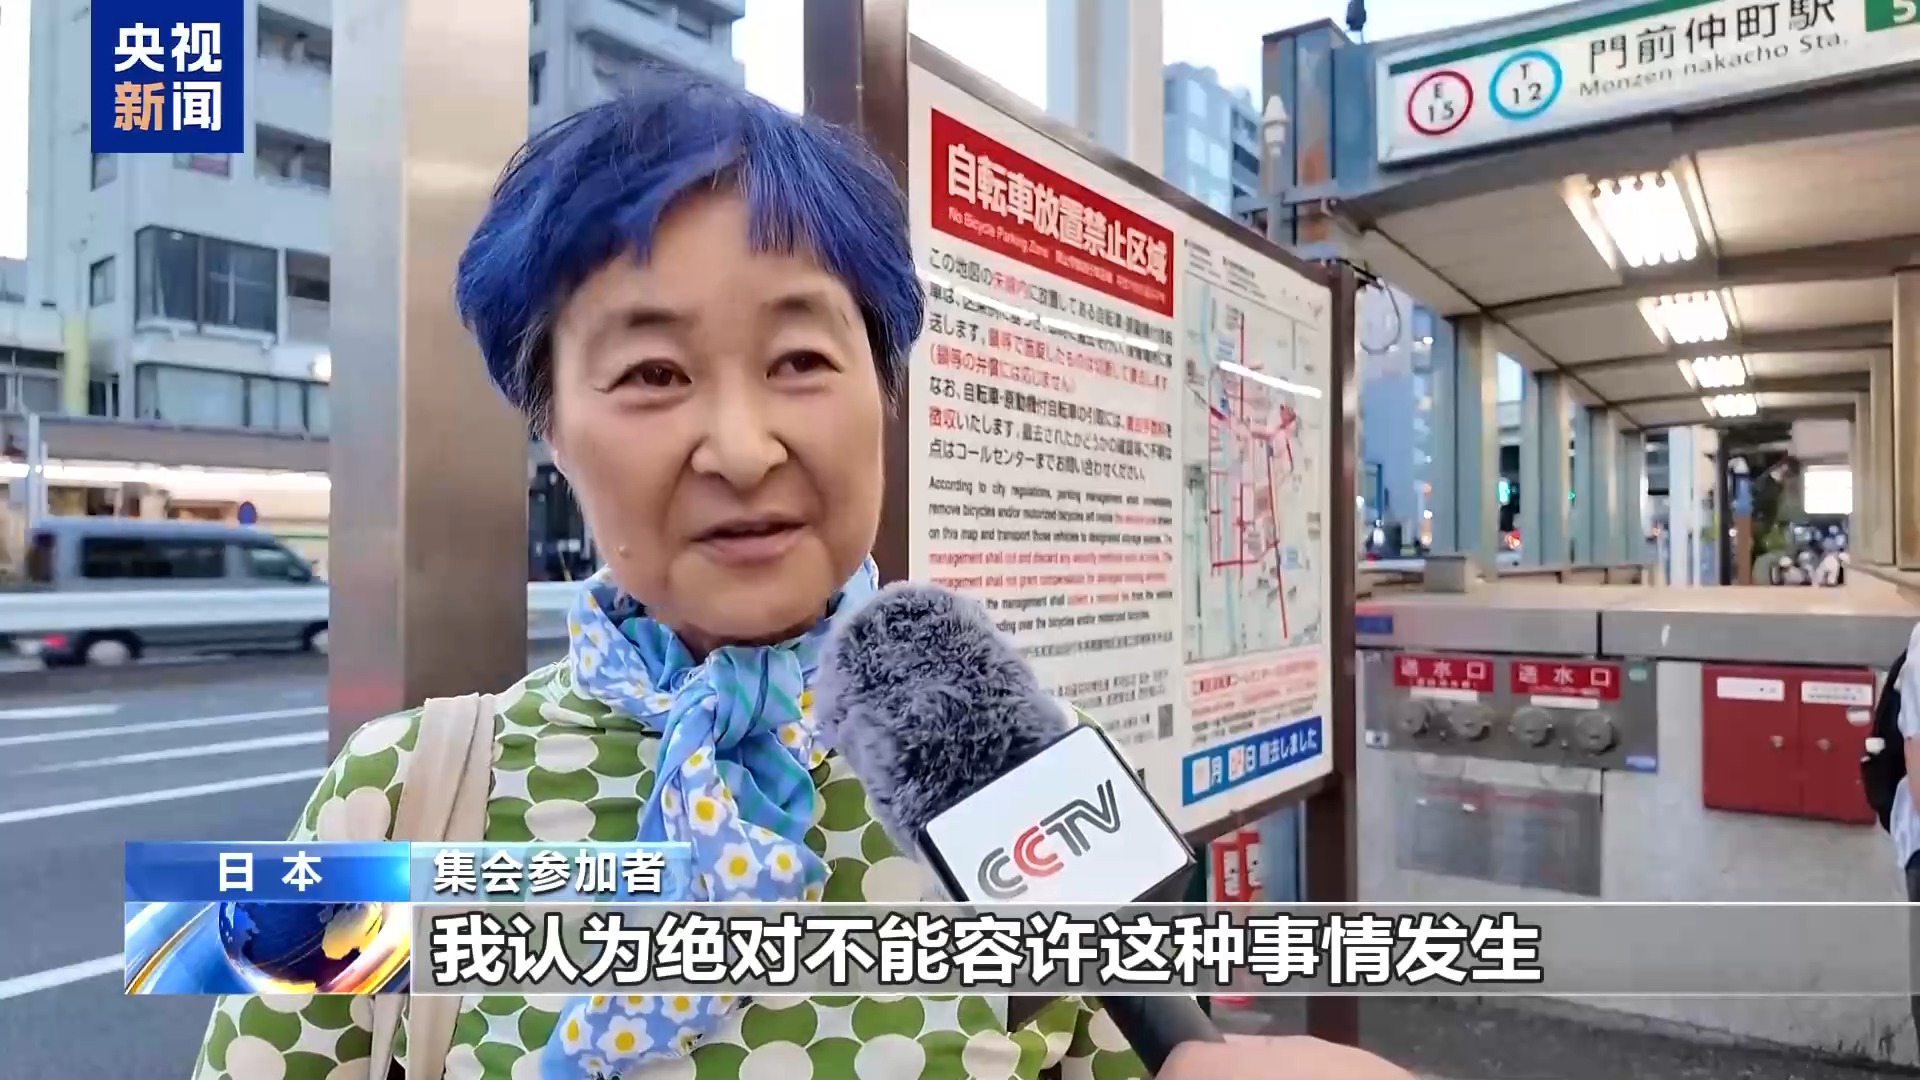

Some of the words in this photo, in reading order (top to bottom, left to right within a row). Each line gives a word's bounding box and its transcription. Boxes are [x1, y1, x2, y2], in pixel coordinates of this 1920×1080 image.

[1590, 0, 1835, 74] 門前仲町駅
[1520, 63, 1530, 81] T
[1579, 68, 1673, 97] Monzen
[1684, 44, 1789, 76] nakacho
[1433, 82, 1442, 99] E
[1512, 82, 1542, 105] 12
[1428, 101, 1455, 123] 15
[949, 143, 1168, 285] 自転車放置禁止区域
[928, 476, 972, 495] According
[977, 778, 1123, 899] CCTV
